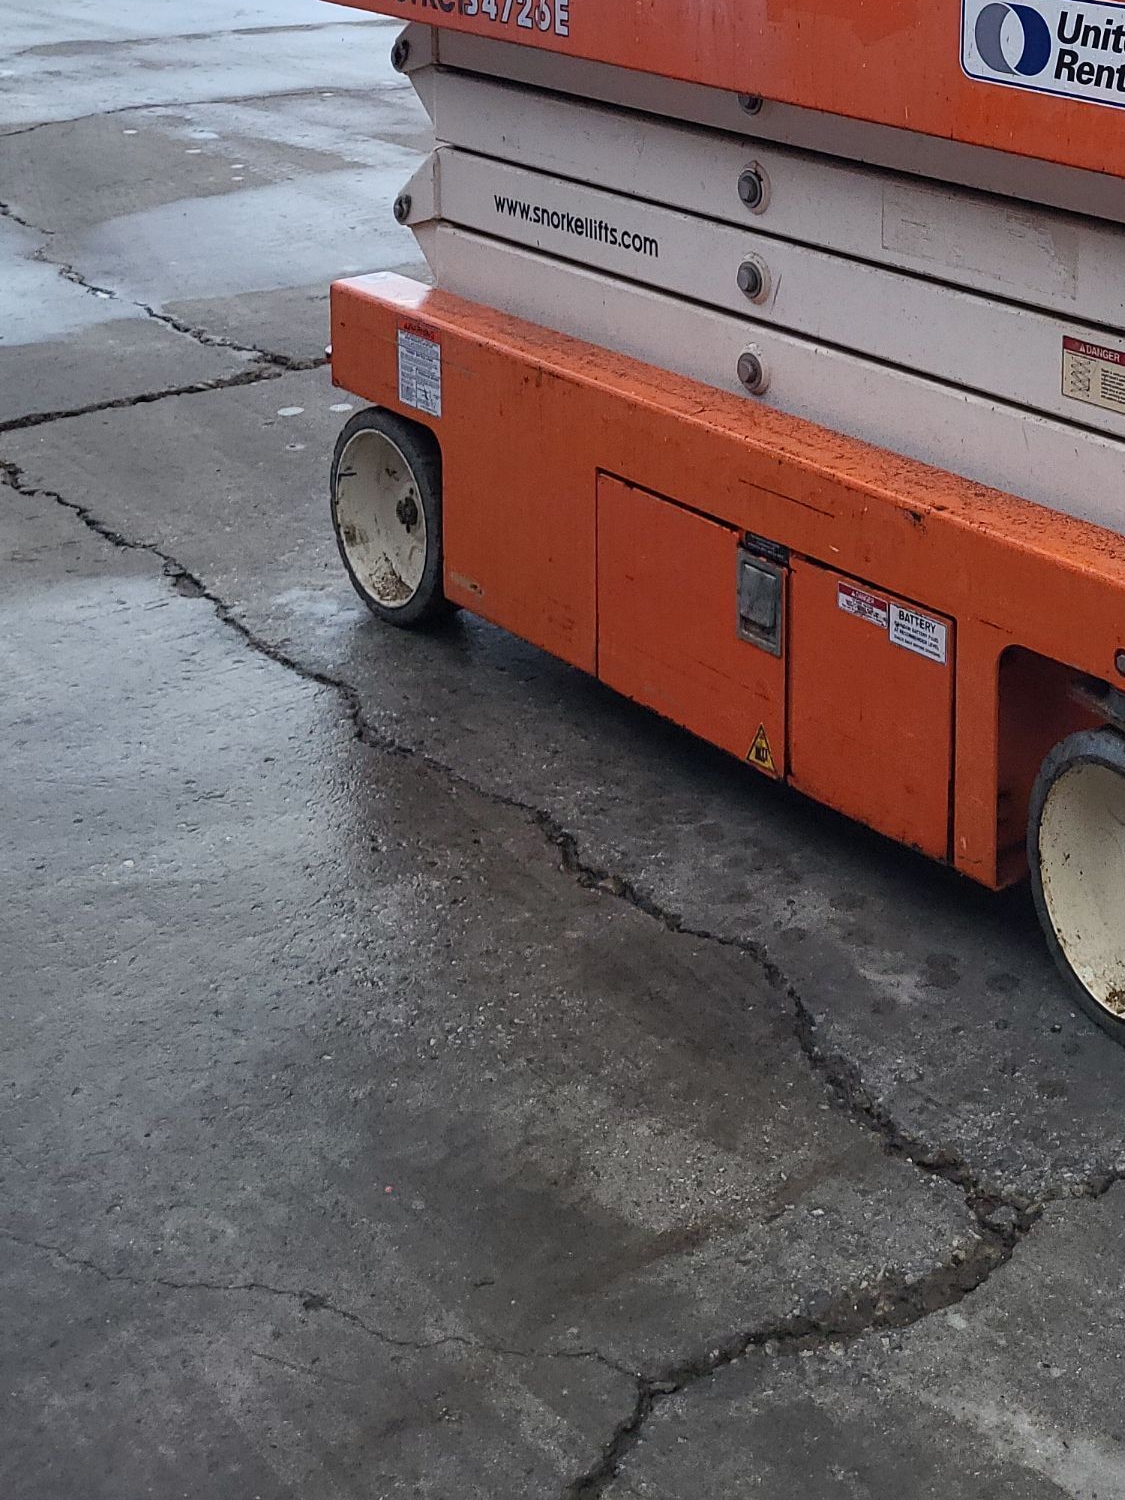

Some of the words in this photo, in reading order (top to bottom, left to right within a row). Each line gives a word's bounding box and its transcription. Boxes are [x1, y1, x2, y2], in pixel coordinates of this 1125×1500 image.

[493, 194, 659, 258] www.snorkellifts.com
[1086, 344, 1120, 363] DANGER
[898, 609, 936, 634] BATTERY
